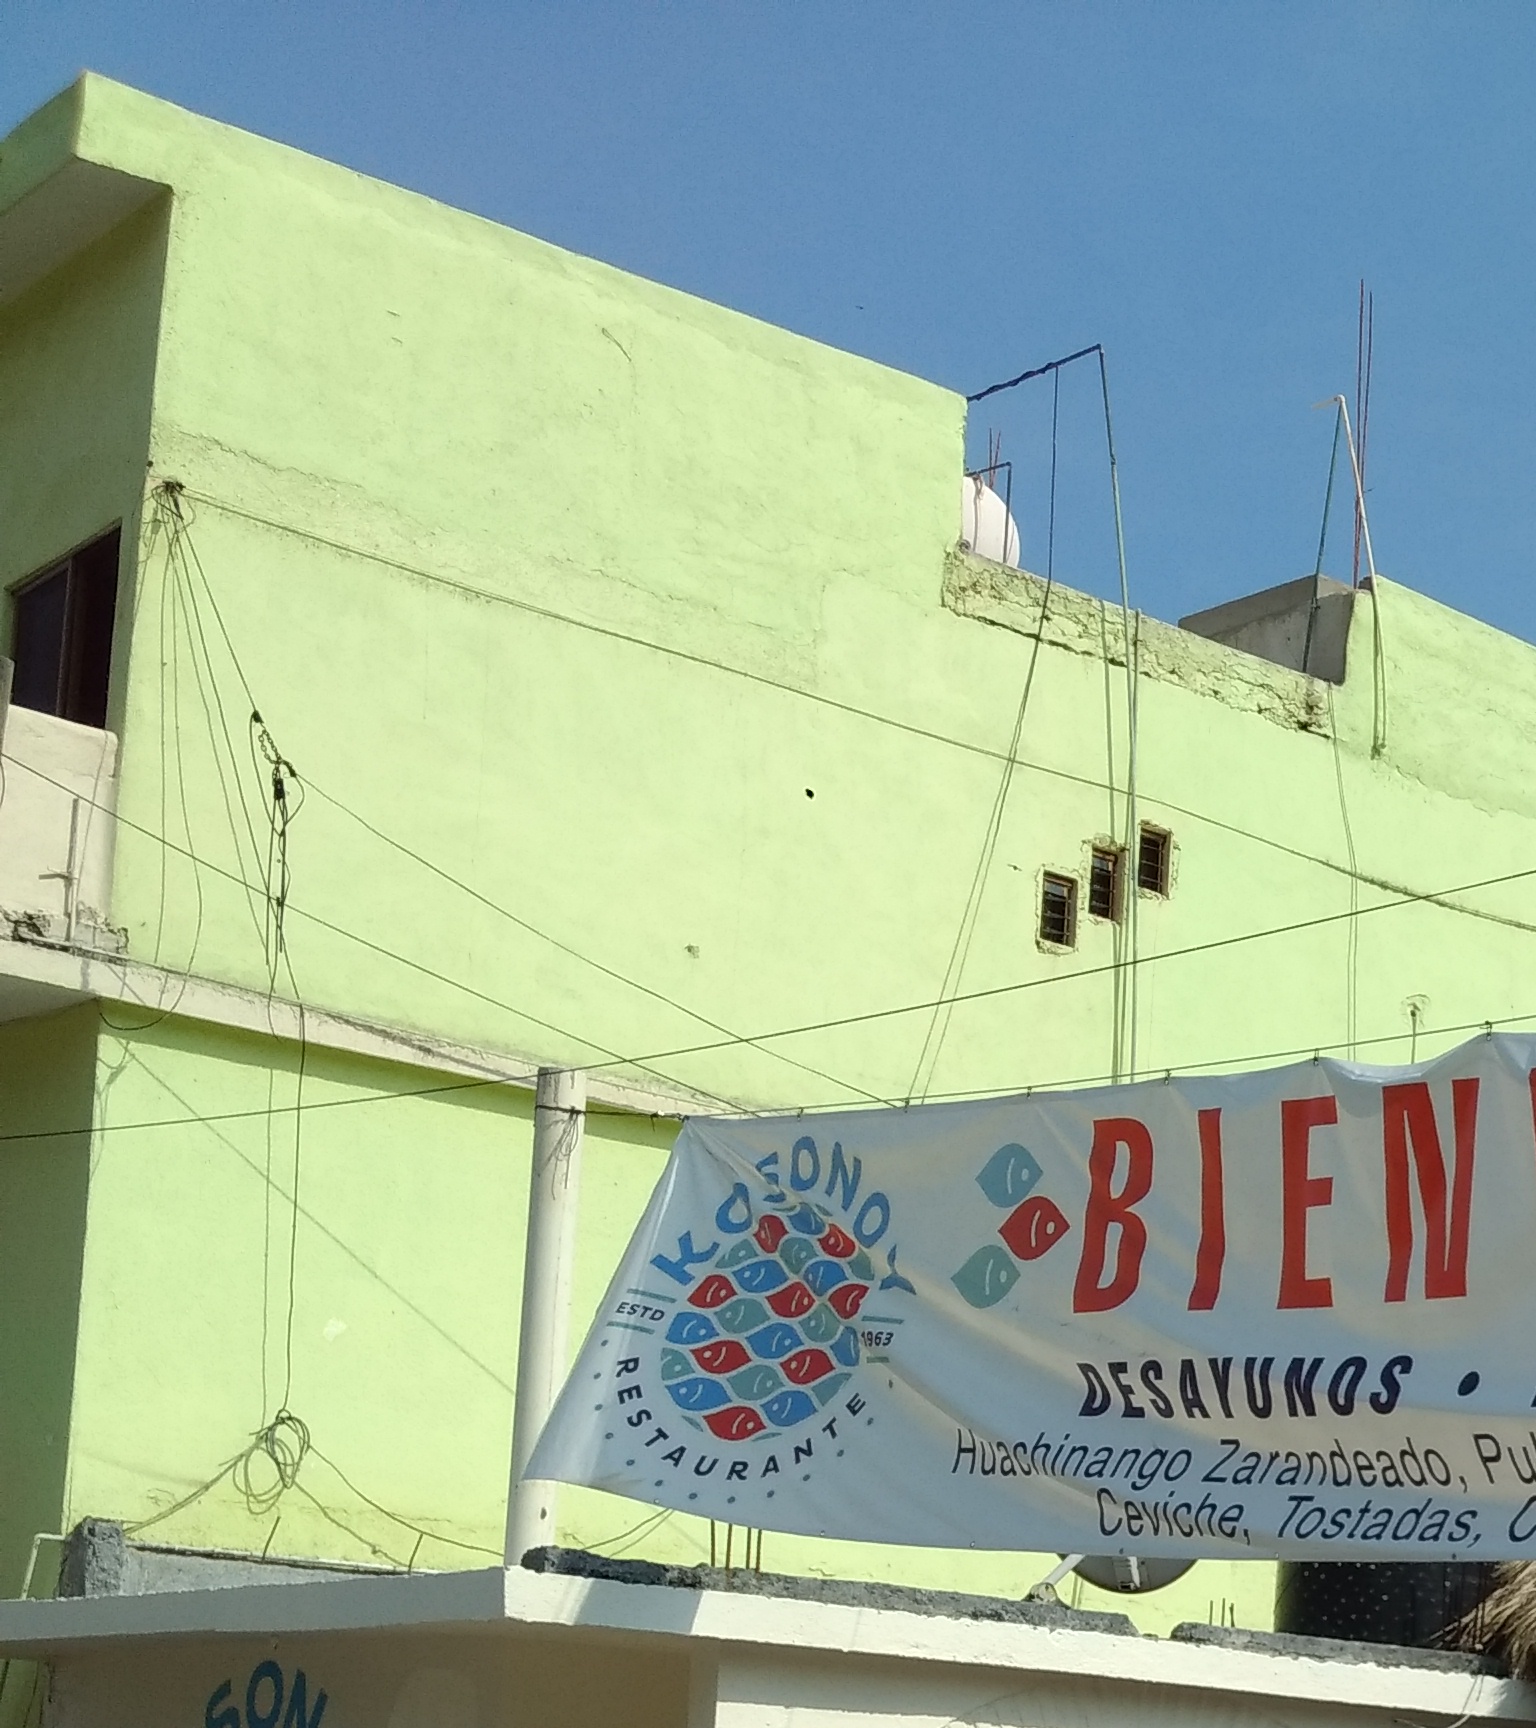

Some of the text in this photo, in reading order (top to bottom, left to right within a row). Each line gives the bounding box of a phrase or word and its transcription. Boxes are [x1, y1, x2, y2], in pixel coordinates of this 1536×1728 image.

[650, 1136, 916, 1295] KOSONOY
[615, 1301, 665, 1322] ESTD
[861, 1330, 894, 1348] 1963
[616, 1356, 867, 1481] RESTAURANTE
[1078, 1354, 1413, 1419] DESAYUNOS
[951, 1428, 1192, 1490] Huachinango
[1203, 1438, 1467, 1493] Zarandeado,
[1096, 1487, 1251, 1546] Ceviche,
[1275, 1496, 1483, 1549] Tostadas,
